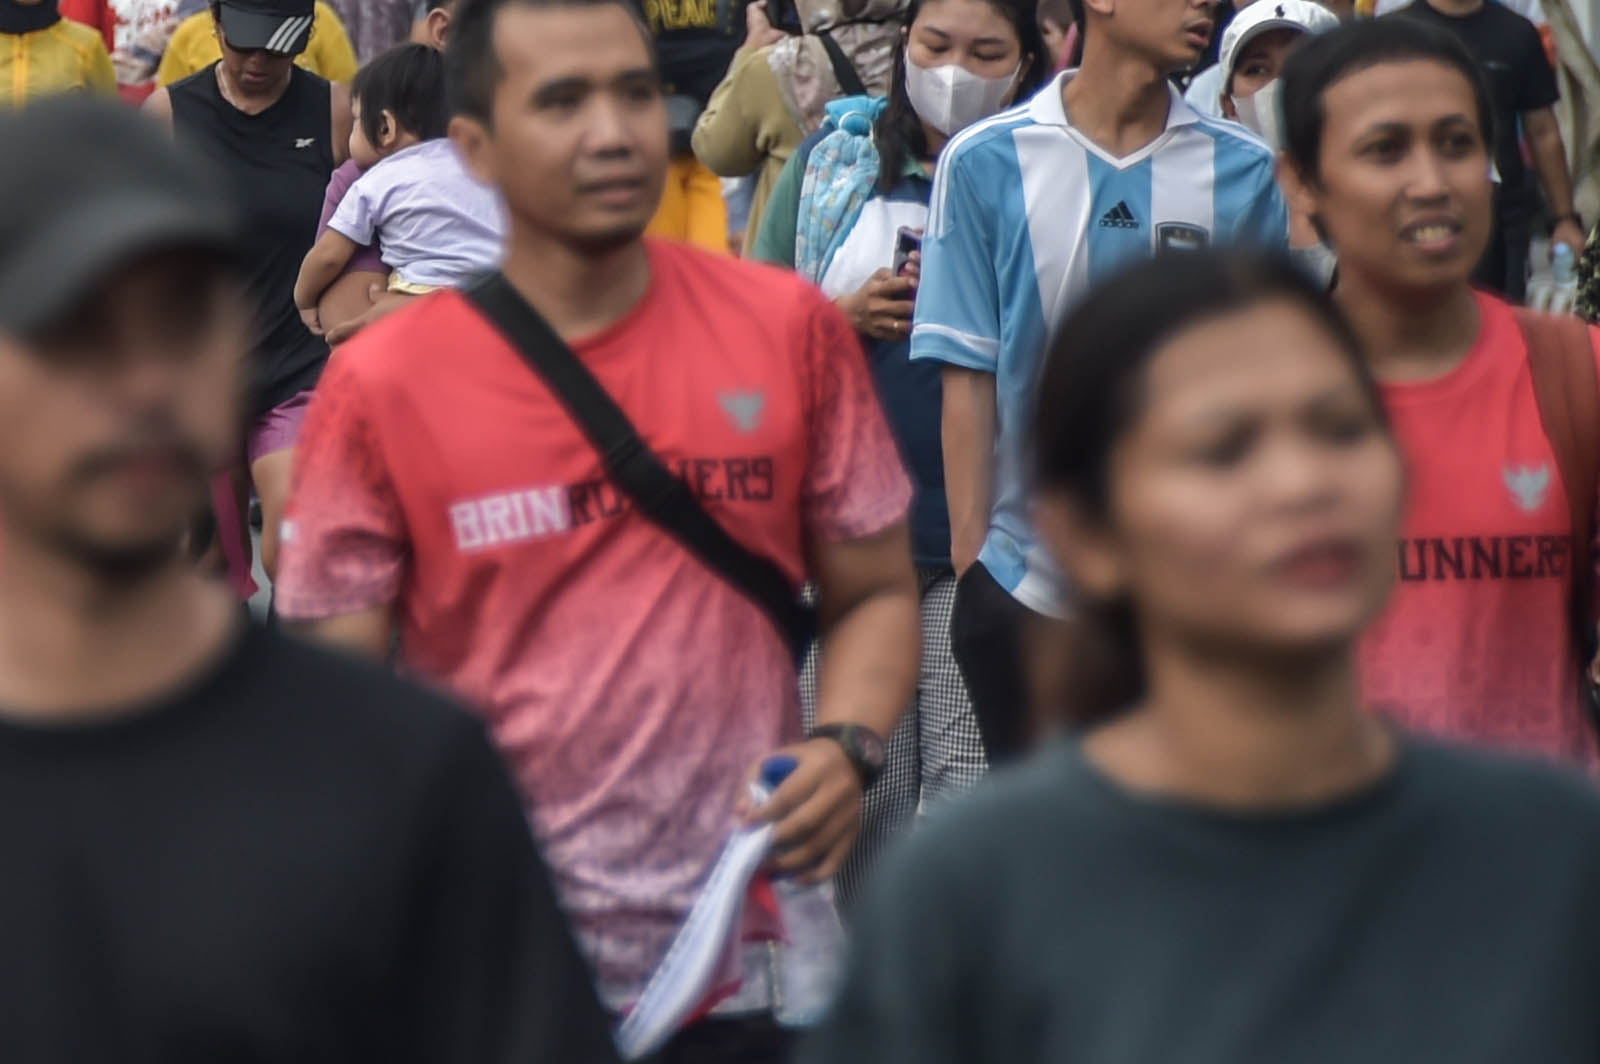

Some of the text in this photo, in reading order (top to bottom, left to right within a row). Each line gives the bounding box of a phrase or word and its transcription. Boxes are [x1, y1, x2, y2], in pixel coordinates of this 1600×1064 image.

[1099, 219, 1139, 229] adidas
[450, 456, 774, 551] BRIN RUERS
[1398, 535, 1571, 582] UNNER
